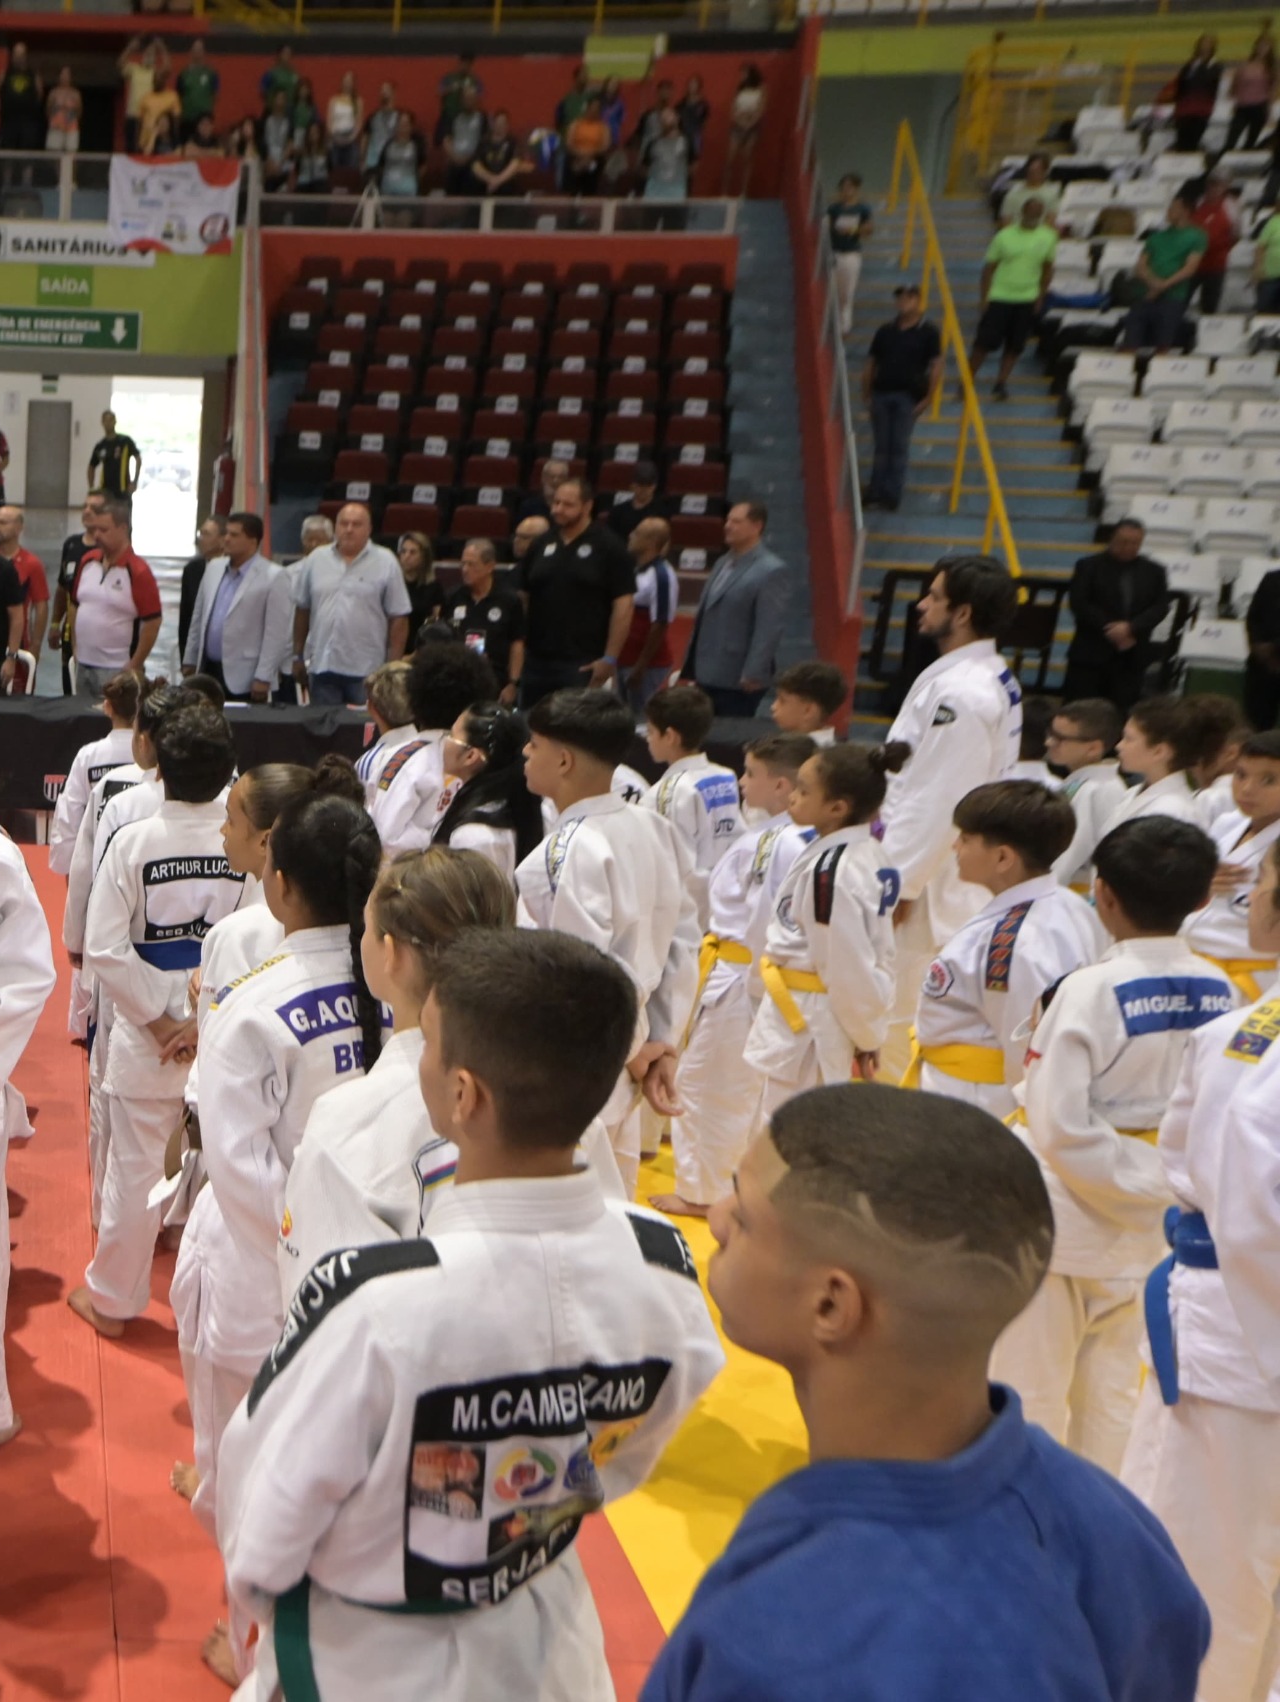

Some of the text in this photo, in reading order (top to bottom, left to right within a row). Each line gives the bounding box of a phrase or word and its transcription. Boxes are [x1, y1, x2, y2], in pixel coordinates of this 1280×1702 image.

[40, 275, 89, 295] SAÍDA
[17, 318, 30, 329] DE
[33, 317, 101, 332] EMERGÊNCIA
[0, 330, 84, 345] EMERGENCY EXIT
[150, 860, 201, 880] ARTHUR
[1123, 995, 1194, 1019] MIGUEL
